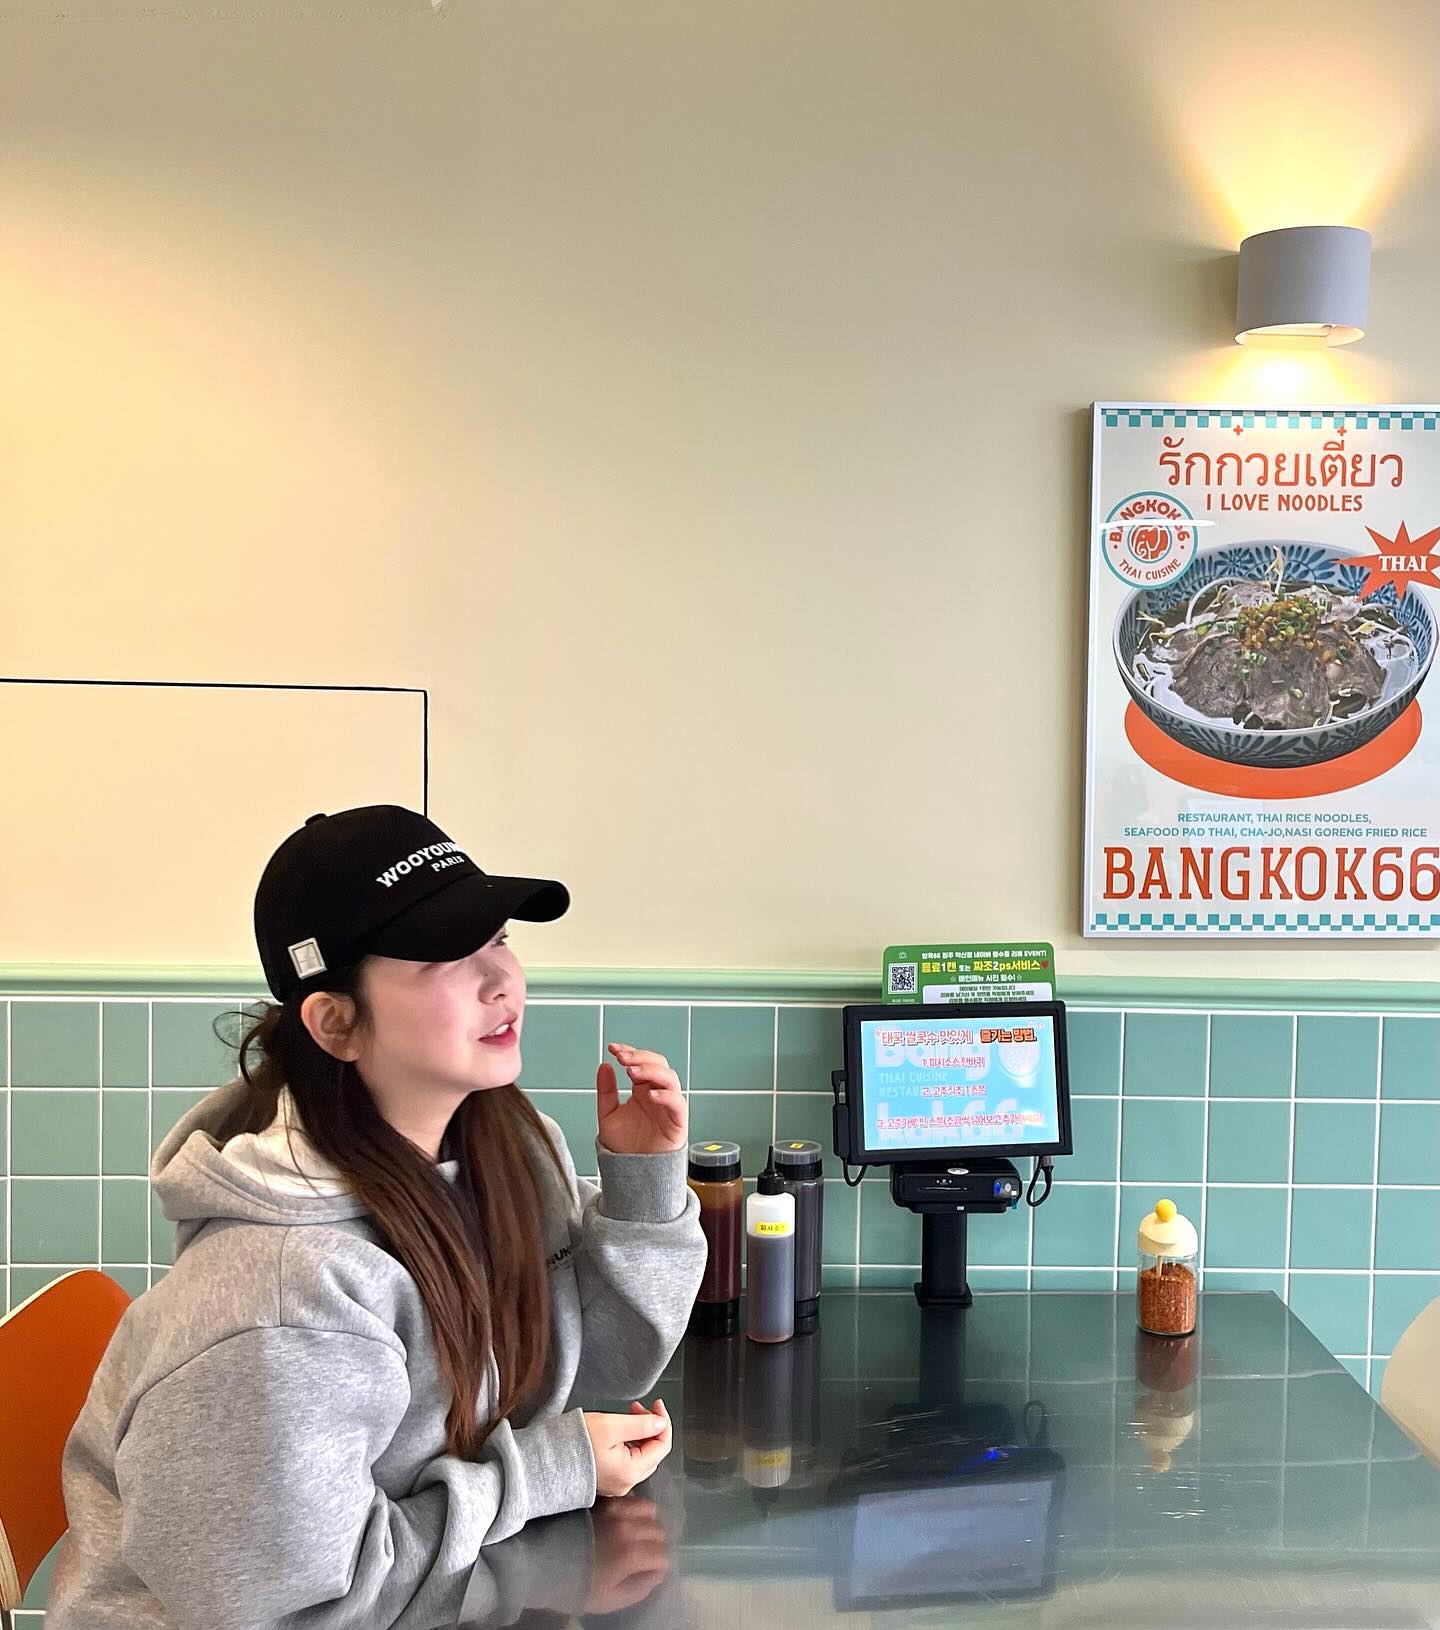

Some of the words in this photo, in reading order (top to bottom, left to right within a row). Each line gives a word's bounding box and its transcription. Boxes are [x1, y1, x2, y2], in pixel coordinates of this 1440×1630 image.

[1206, 494, 1212, 511] I
[1221, 494, 1269, 511] LOVE
[1278, 494, 1363, 512] NOODLES
[1109, 499, 1191, 543] BNGKOK6
[1119, 558, 1142, 580] THAI
[1145, 558, 1182, 580] CUISINE
[1378, 555, 1429, 573] THAI
[1177, 813, 1253, 825] RESTAURANT,
[1256, 813, 1283, 823] THAI
[1286, 813, 1311, 823] RICE
[1314, 813, 1372, 825] NOODLES,
[1124, 827, 1180, 838] SEAFOOD
[1182, 827, 1205, 837] PAD
[1208, 827, 1237, 839] THAI,
[1314, 827, 1363, 838] GORENG
[1366, 827, 1398, 838] FRIED
[1401, 827, 1427, 838] RICE
[1103, 846, 1440, 902] BANGKOK66
